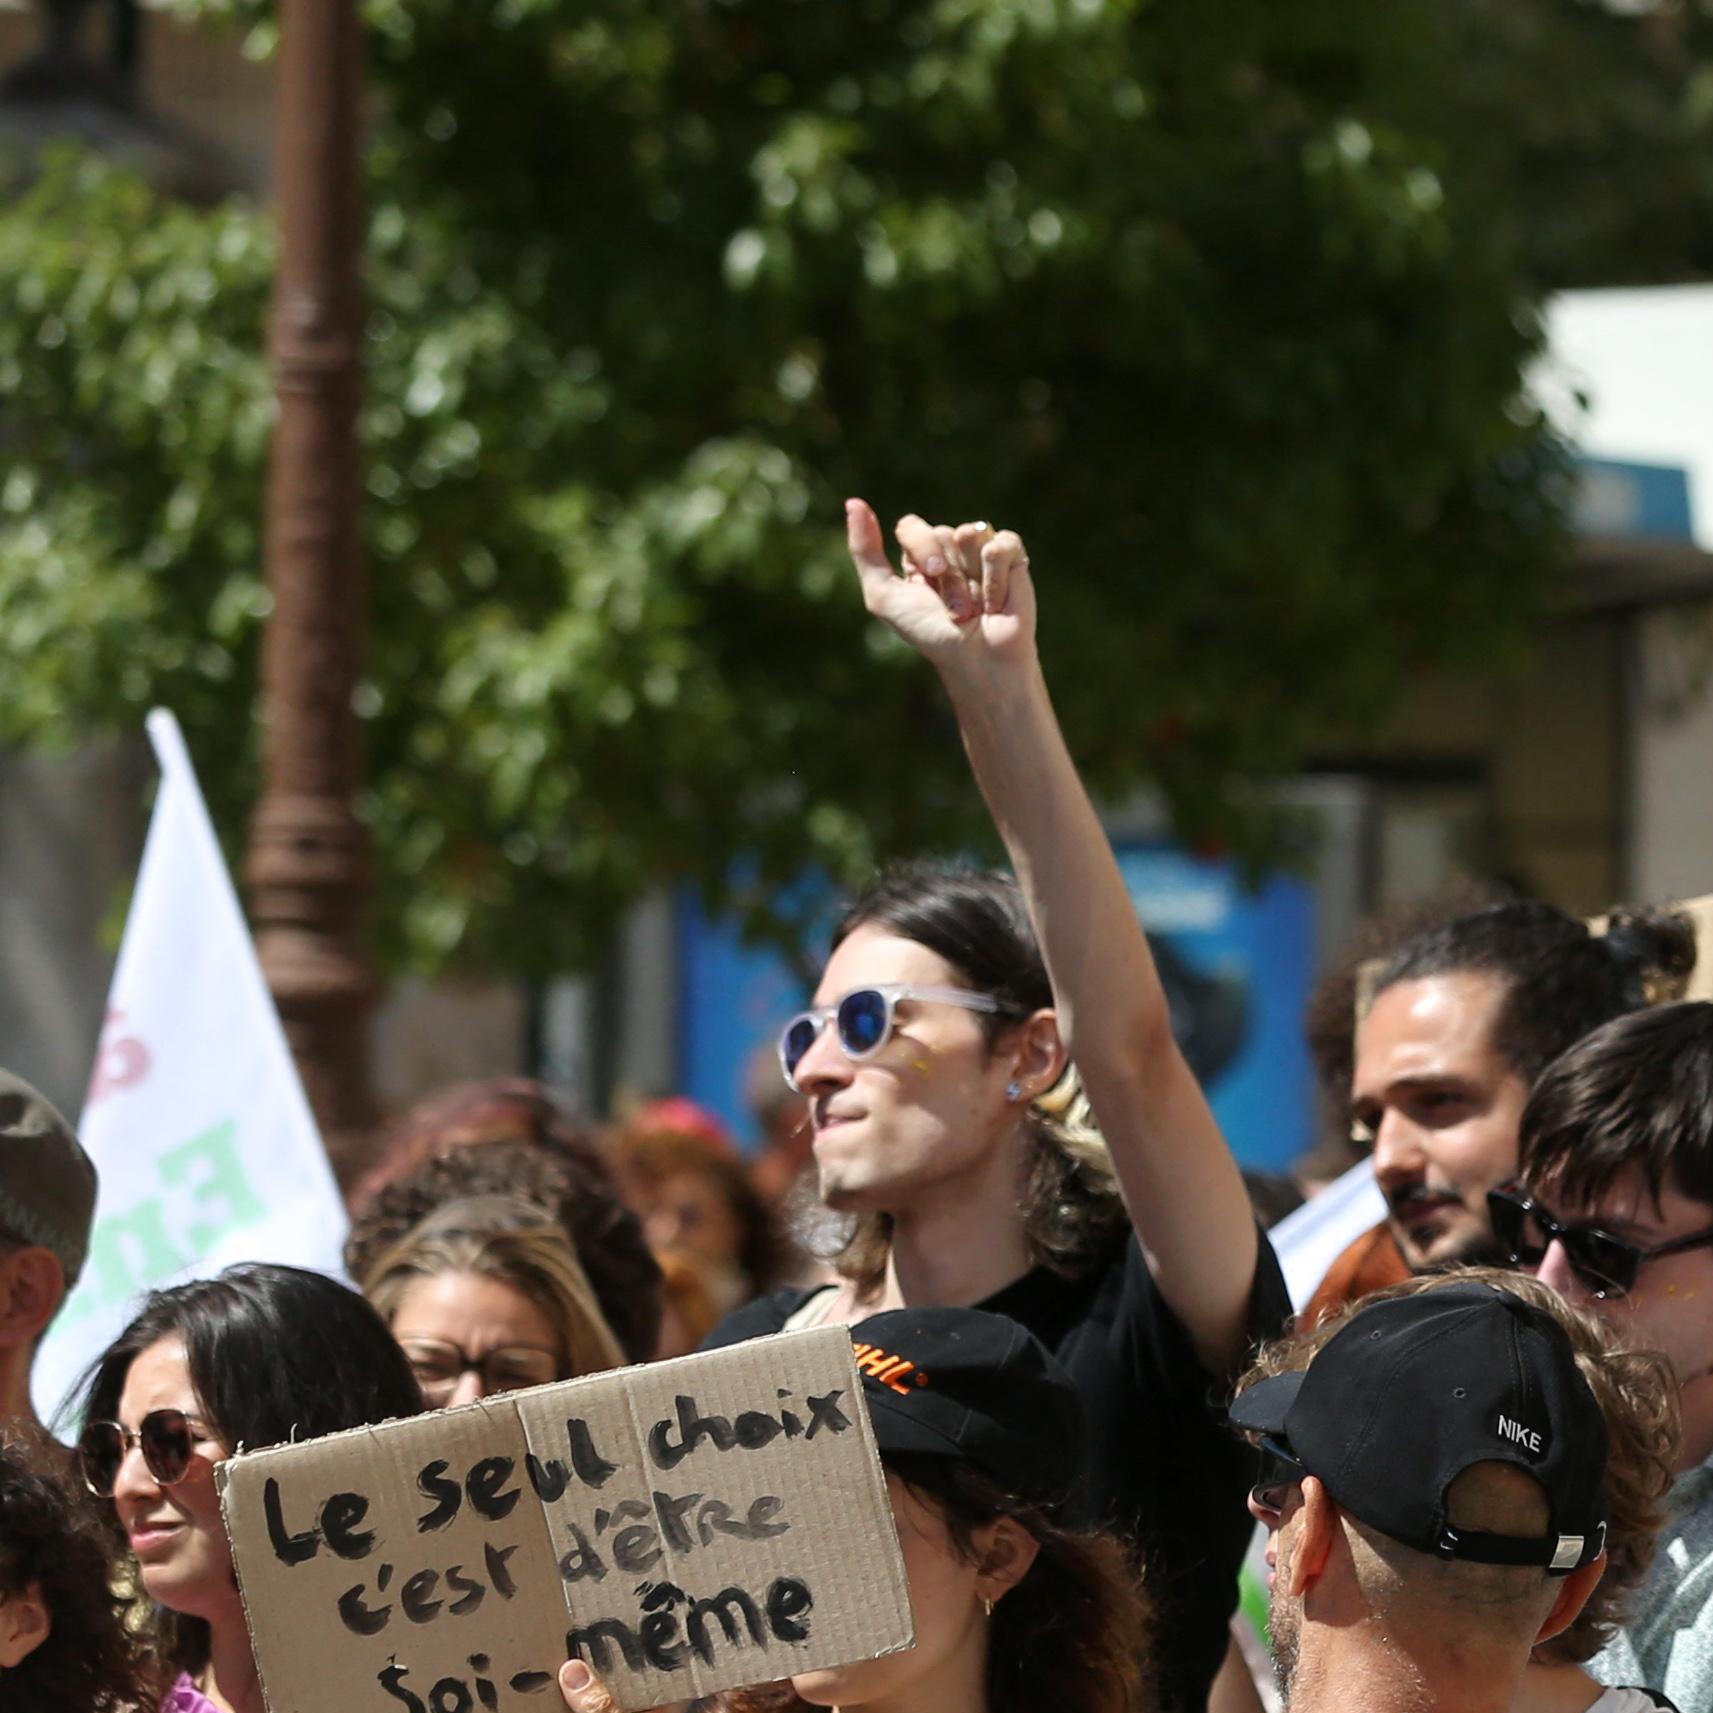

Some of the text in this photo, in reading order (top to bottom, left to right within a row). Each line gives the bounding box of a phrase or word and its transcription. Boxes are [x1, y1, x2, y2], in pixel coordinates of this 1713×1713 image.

[263, 1388, 852, 1567] Le seul choix
[1497, 1414, 1542, 1454] NIKE
[337, 1541, 520, 1636] c'est
